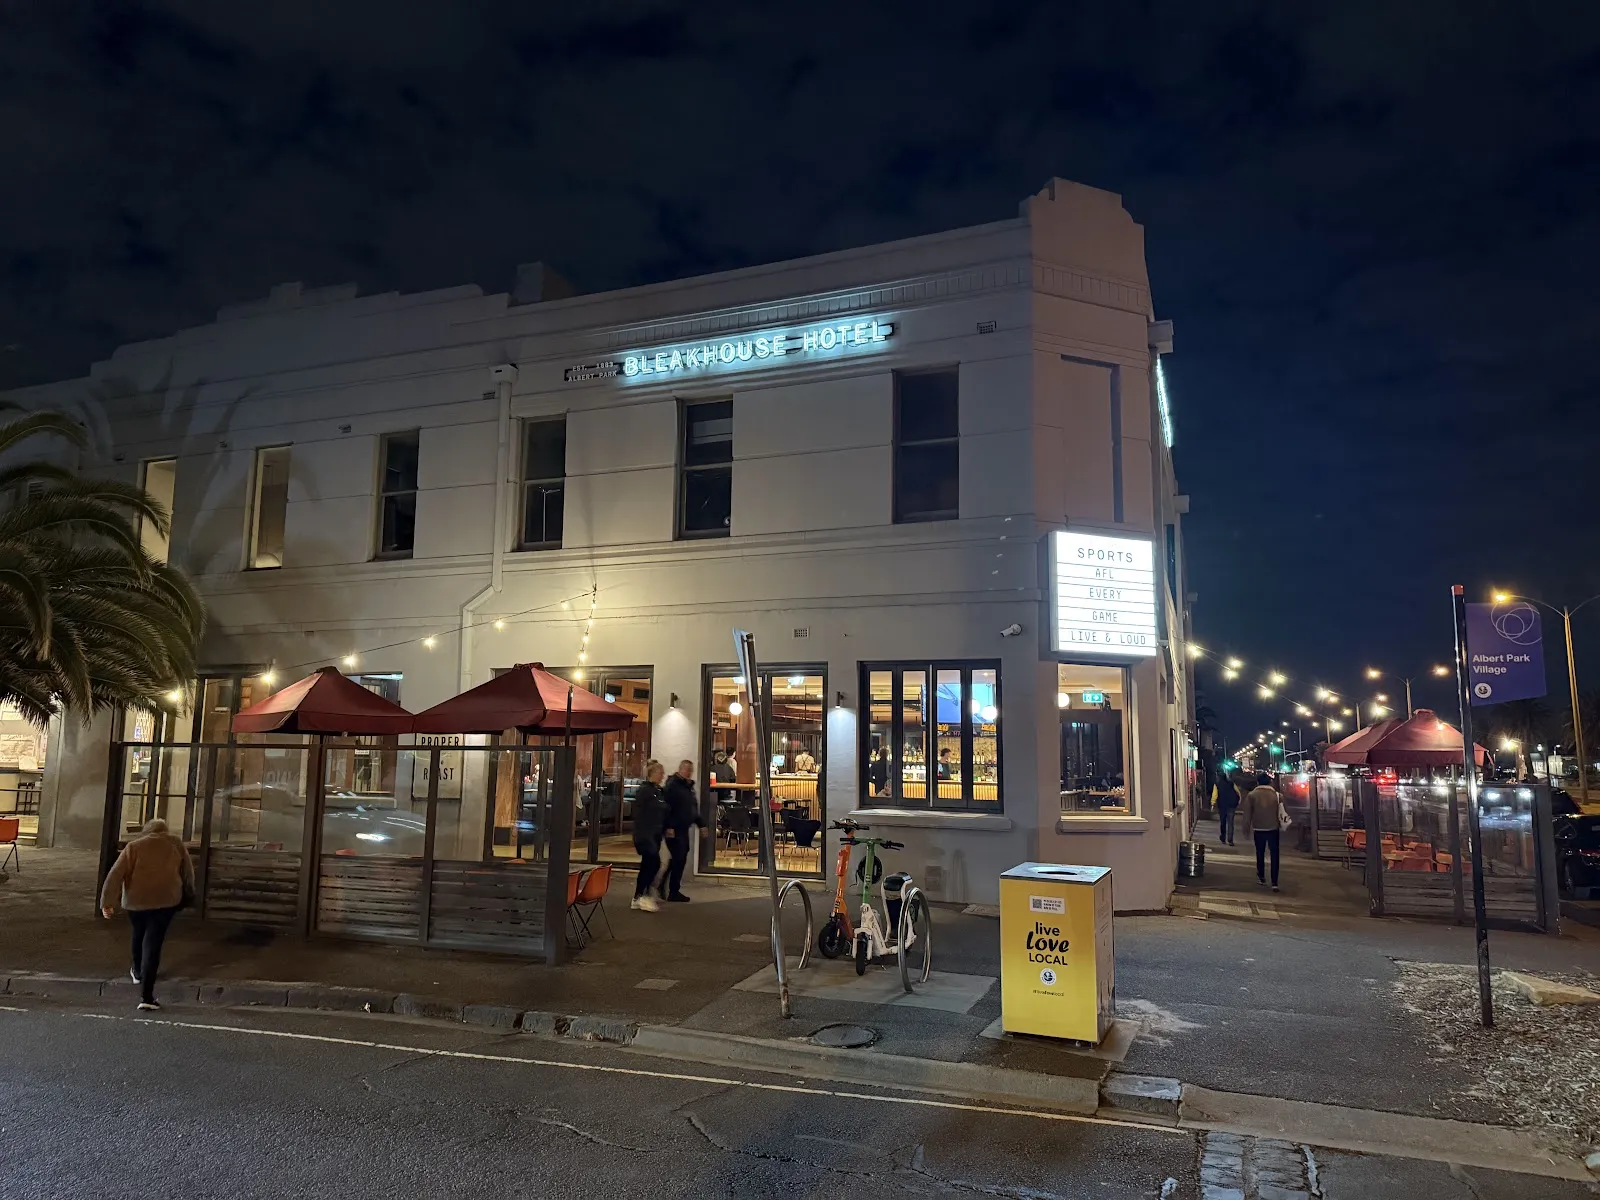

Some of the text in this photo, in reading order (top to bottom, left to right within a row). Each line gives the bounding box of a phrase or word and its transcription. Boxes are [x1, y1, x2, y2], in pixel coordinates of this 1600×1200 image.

[624, 320, 886, 377] BLEAKHOUSE HOTEL
[568, 370, 617, 382] ALBERT PARK
[1077, 547, 1133, 563] SPORTS
[1095, 568, 1114, 579] AFL
[1089, 587, 1122, 600] EVERY
[1092, 610, 1118, 623] GAME
[1071, 631, 1146, 645] LIVE & LOUD
[1472, 653, 1531, 663] Albert Park
[1473, 666, 1507, 675] Village
[423, 767, 455, 780] RST
[1035, 921, 1061, 937] live
[1028, 952, 1068, 966] LOCAL
